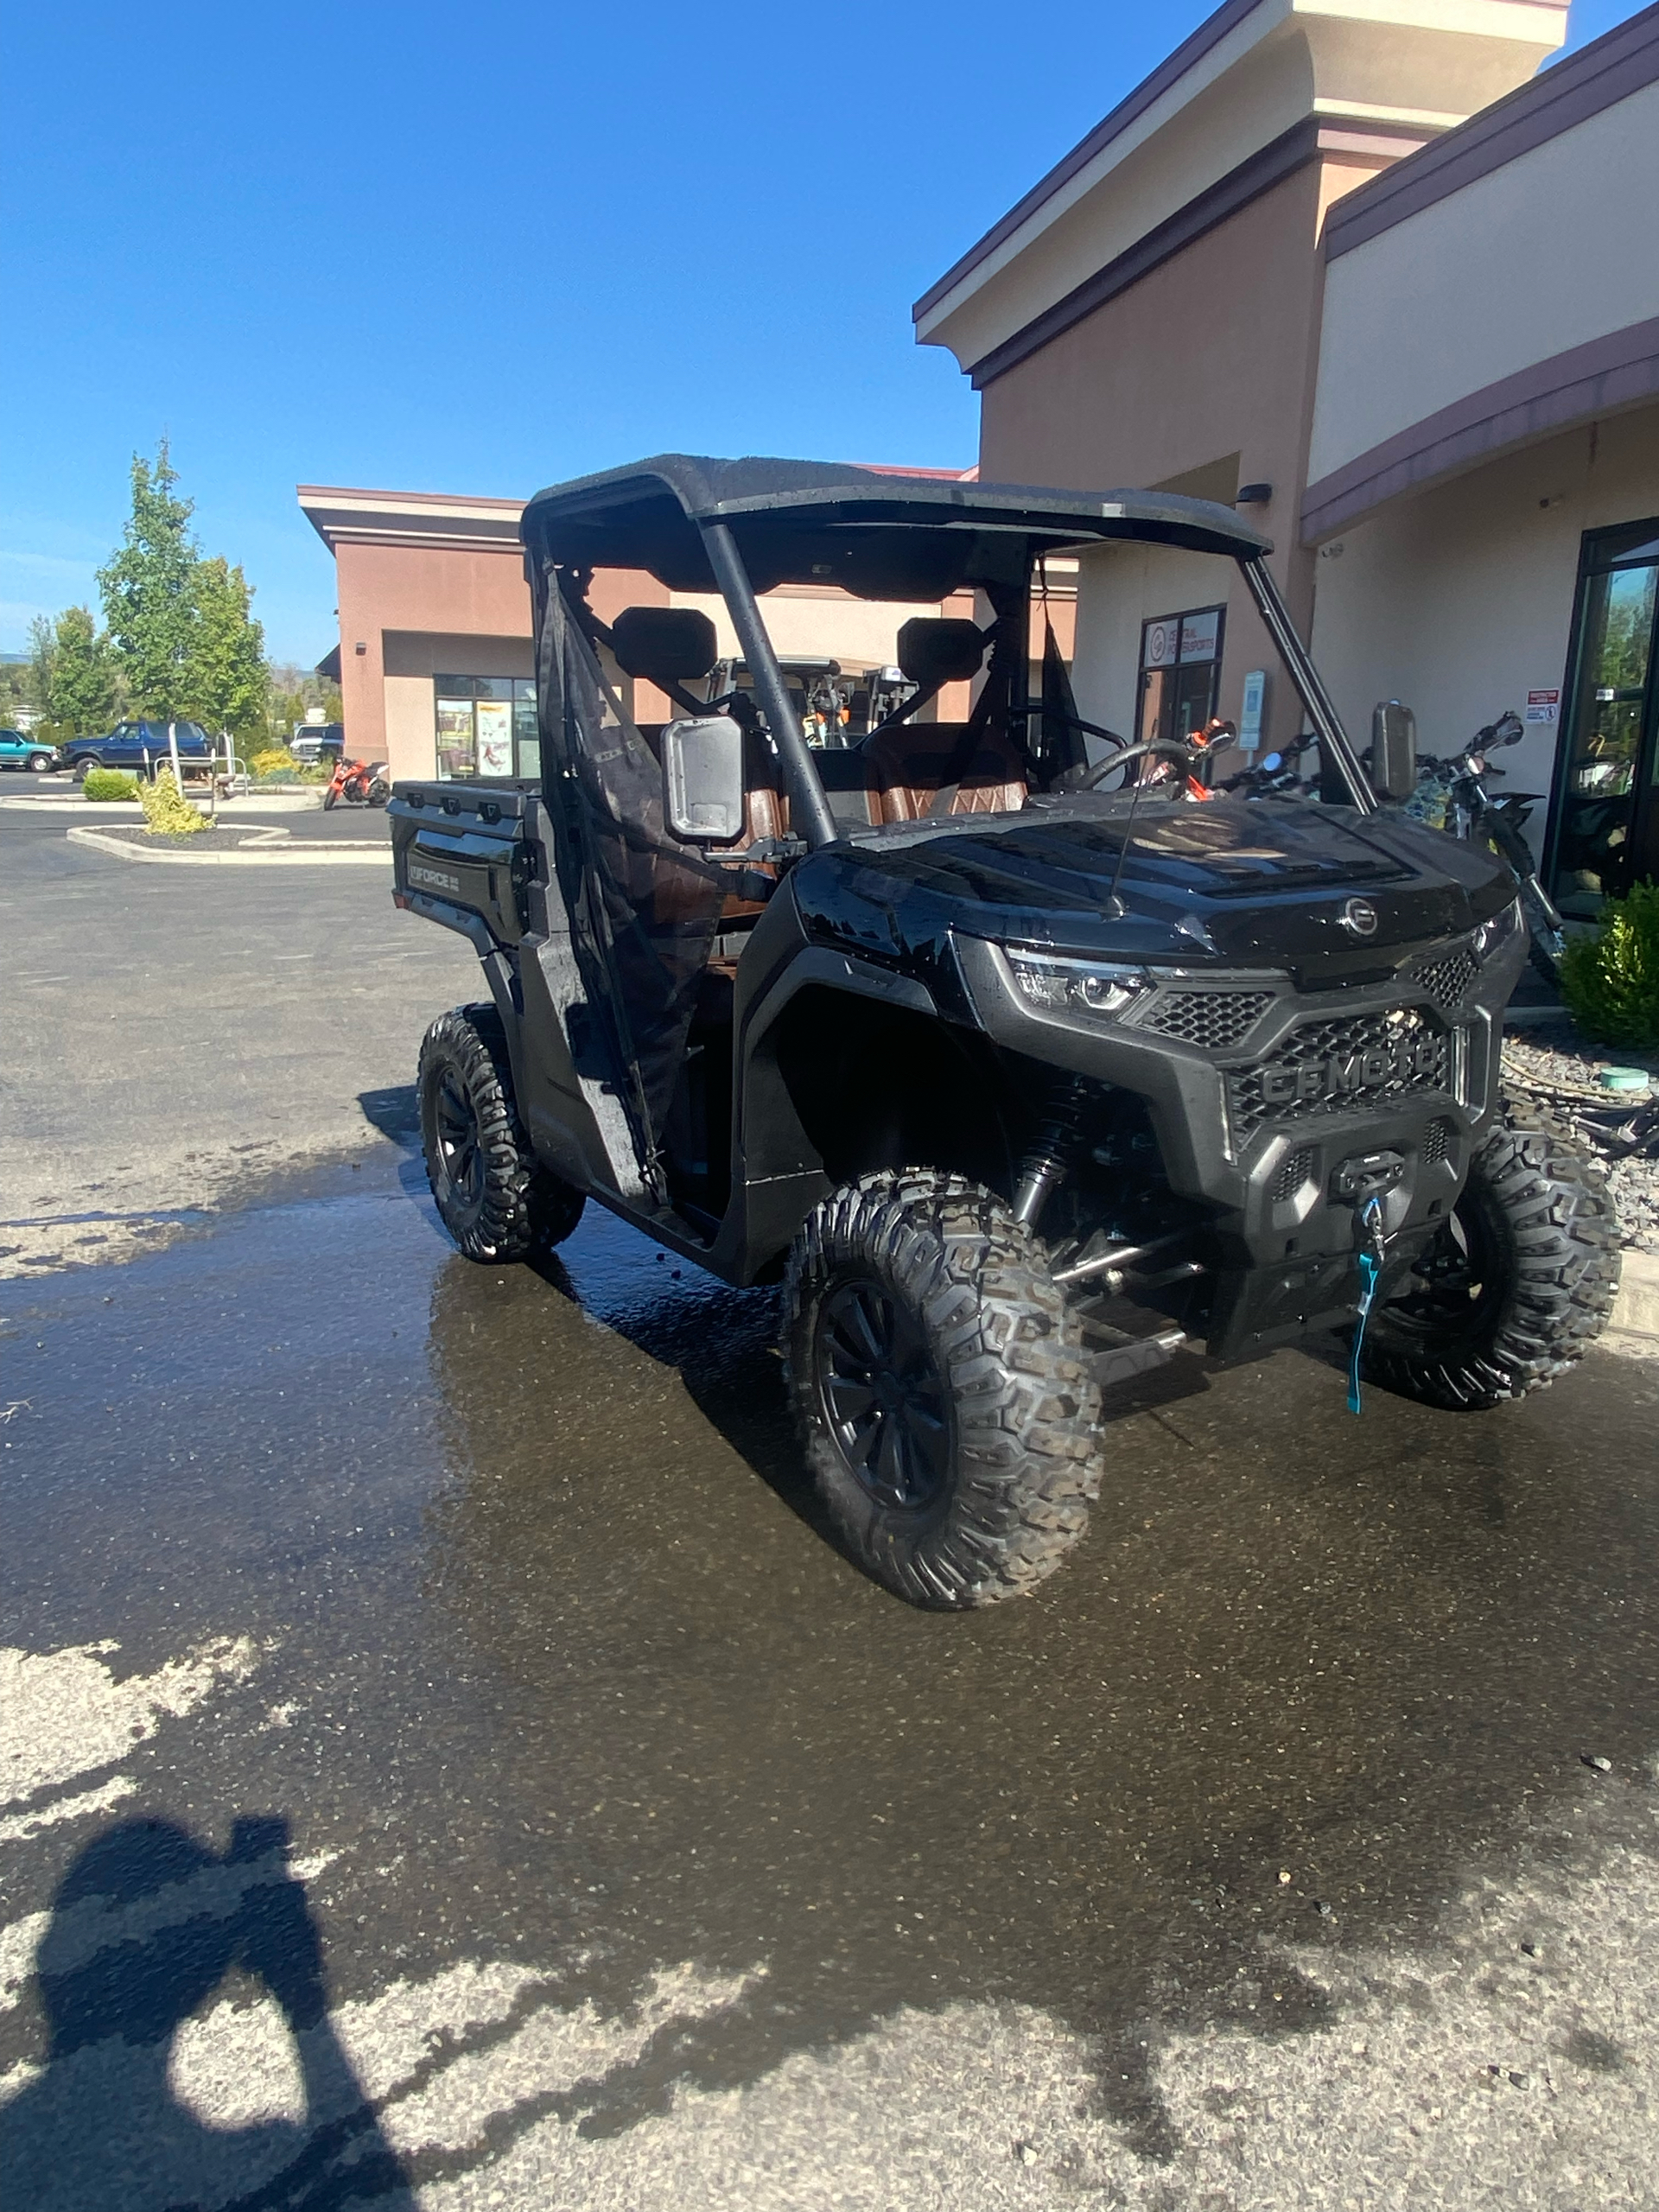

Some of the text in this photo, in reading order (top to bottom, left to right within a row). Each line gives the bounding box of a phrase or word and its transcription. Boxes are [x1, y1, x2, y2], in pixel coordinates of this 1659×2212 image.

[1169, 628, 1198, 641] CETRAL
[1167, 638, 1214, 654] POERSPORTS
[1262, 1039, 1440, 1103] CFMOTO
